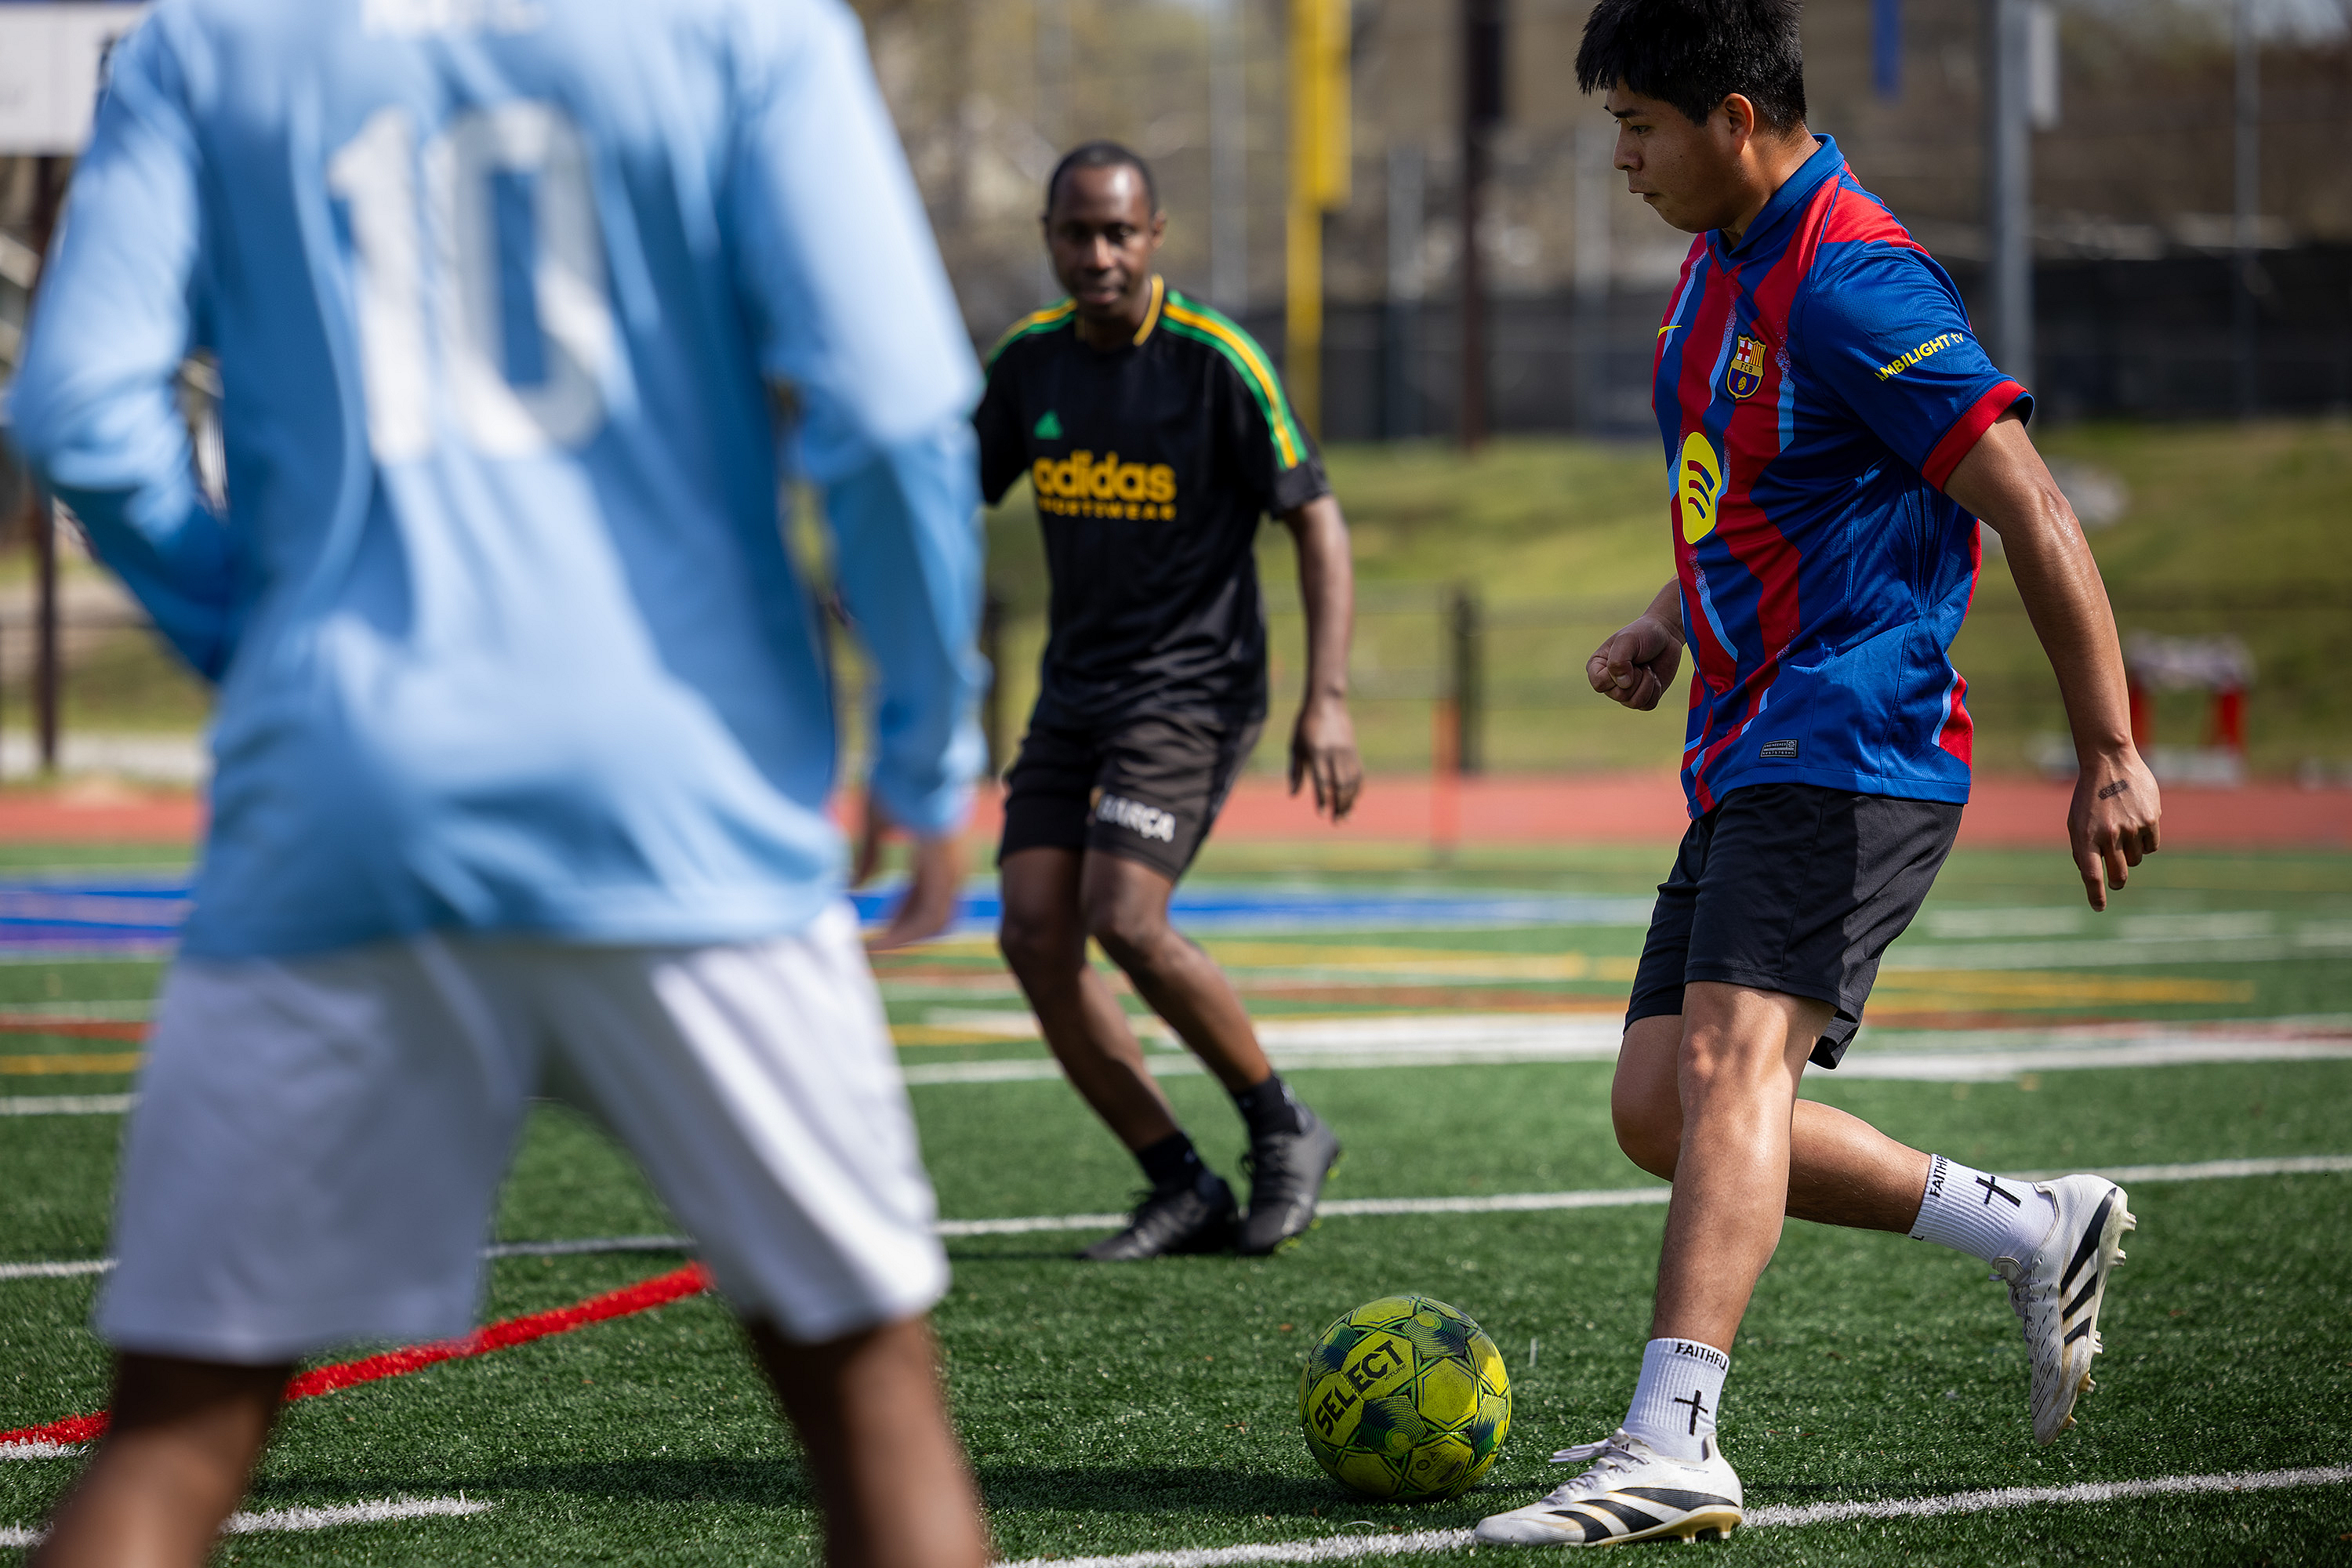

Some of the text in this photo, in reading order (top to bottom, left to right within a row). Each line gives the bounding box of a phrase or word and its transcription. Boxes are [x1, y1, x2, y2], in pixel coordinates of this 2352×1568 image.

[326, 100, 608, 464] 10
[1951, 332, 1964, 343] tv
[1740, 362, 1753, 373] FCB
[1033, 449, 1177, 503] adidas
[1315, 1339, 1404, 1438] SELECT
